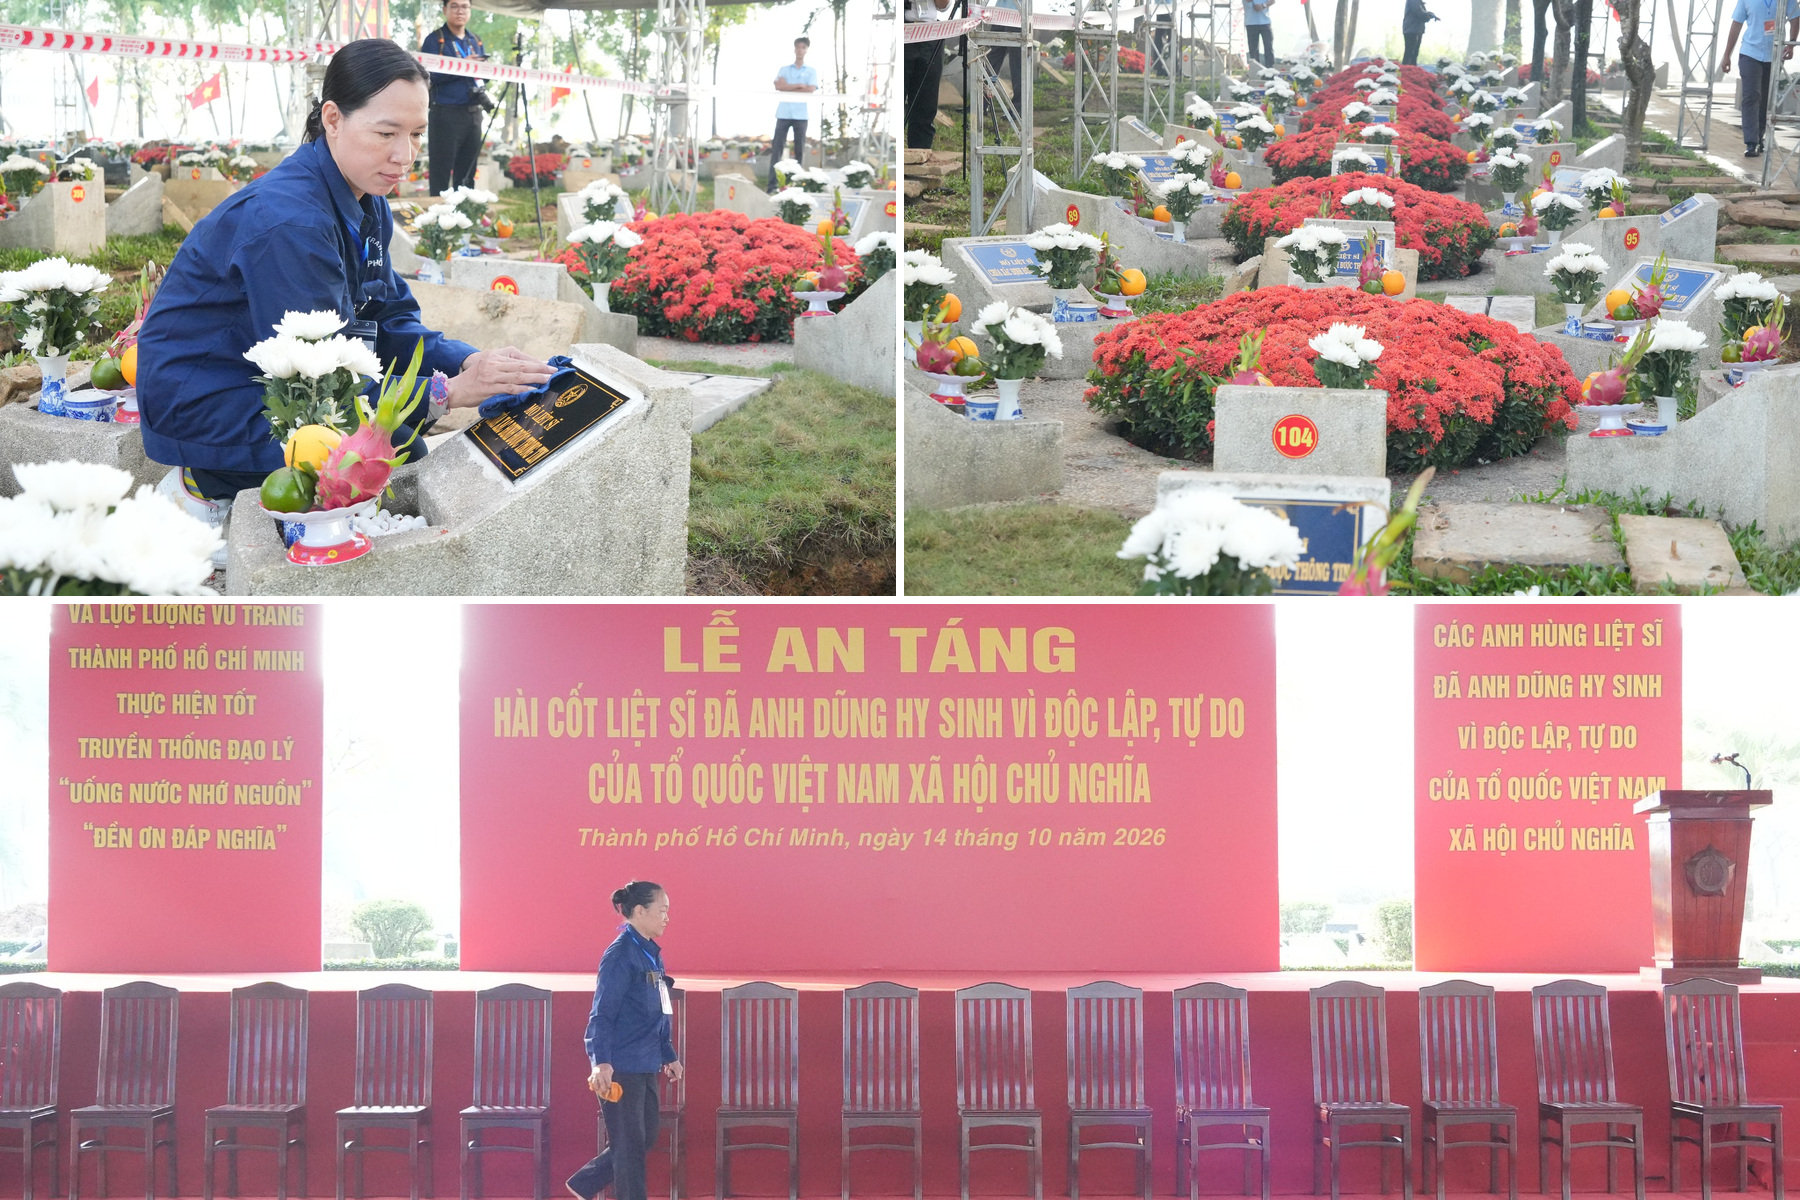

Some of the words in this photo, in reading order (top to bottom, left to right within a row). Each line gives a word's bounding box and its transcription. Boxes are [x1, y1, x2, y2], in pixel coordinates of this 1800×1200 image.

[1552, 155, 1560, 163] 87
[1068, 209, 1078, 222] 89
[1627, 233, 1638, 245] 95
[1278, 426, 1313, 448] 104
[1294, 557, 1330, 582] THÔNG
[100, 604, 137, 629] LỰC
[142, 604, 206, 629] LƯỢNG
[241, 605, 305, 627] TRANG
[664, 609, 741, 673] LỄ
[767, 627, 865, 673] AN
[889, 617, 1076, 673] TÁNG
[1433, 620, 1475, 648] CÁC
[1481, 623, 1524, 648] ANH
[1530, 620, 1588, 648] HÙNG
[1593, 618, 1636, 652] LIỆT
[1641, 619, 1664, 648] SĨ
[68, 643, 133, 670] THÀNH
[138, 641, 178, 670] PHỐ
[183, 642, 209, 671] HỒ
[215, 645, 248, 671] CHÍ
[253, 650, 305, 672] MINH
[1433, 670, 1461, 699] ĐÃ
[1468, 675, 1510, 699] ANH
[1517, 670, 1573, 699] DŨNG
[1579, 674, 1606, 698] HY
[1612, 674, 1663, 698] SINH
[117, 690, 166, 719] THỰC
[172, 690, 217, 719] HIỆN
[223, 687, 257, 716] TỐT
[494, 688, 538, 738] HÀI
[548, 682, 598, 738] CỐT
[607, 689, 660, 748] LIỆT
[669, 689, 696, 738] SĨ
[704, 689, 740, 738] ĐÃ
[749, 697, 805, 738] ANH
[813, 689, 887, 738] DŨNG
[896, 697, 930, 738] HY
[938, 697, 1003, 739] SINH
[1011, 688, 1037, 738] VÌ
[1044, 688, 1099, 747] ĐỘC
[1107, 688, 1161, 747] LẬP,
[1169, 693, 1205, 747] TỰ
[1210, 697, 1245, 738] DO
[78, 732, 153, 760] TRUYỀN
[159, 731, 222, 761] THỐNG
[227, 739, 267, 764] ĐẠO
[272, 736, 295, 761] LÝ
[1458, 721, 1477, 750] VÌ
[1483, 721, 1525, 754] ĐỘC
[1531, 720, 1572, 754] LẬP,
[1579, 723, 1606, 753] TỰ
[1609, 725, 1638, 750] DO
[129, 779, 182, 805] NƯỚC
[188, 780, 228, 806] NHỚ
[588, 749, 643, 804] CỦA
[651, 747, 683, 804] TỔ
[692, 748, 764, 808] QUỐC
[772, 754, 829, 813] VIỆT
[837, 763, 900, 804] NAM
[908, 755, 945, 804] XÃ
[953, 754, 998, 813] HỘI
[1006, 748, 1060, 804] CHỦ
[1068, 754, 1152, 804] NGHĨA
[1428, 769, 1471, 801] CỦA
[1476, 767, 1503, 801] TỔ
[1508, 769, 1563, 802] QUỐC
[1569, 771, 1612, 805] VIỆT
[1618, 776, 1667, 800] NAM
[139, 827, 166, 850] ƠN
[172, 825, 211, 850] ĐÁP
[577, 827, 648, 847] Thành
[654, 825, 703, 852] phố
[705, 826, 738, 847] Hồ
[743, 827, 782, 847] Chí
[789, 828, 850, 851] Minh,
[858, 827, 915, 851] ngày
[922, 829, 947, 846] 14
[953, 828, 1020, 851] tháng
[1027, 828, 1053, 846] 10
[1057, 829, 1107, 847] năm
[1113, 828, 1167, 847] 2026
[1448, 824, 1477, 851] XÃ
[1483, 823, 1517, 857] HỘI
[1523, 820, 1565, 851] CHỦ
[1571, 823, 1635, 851] NGHĨA
